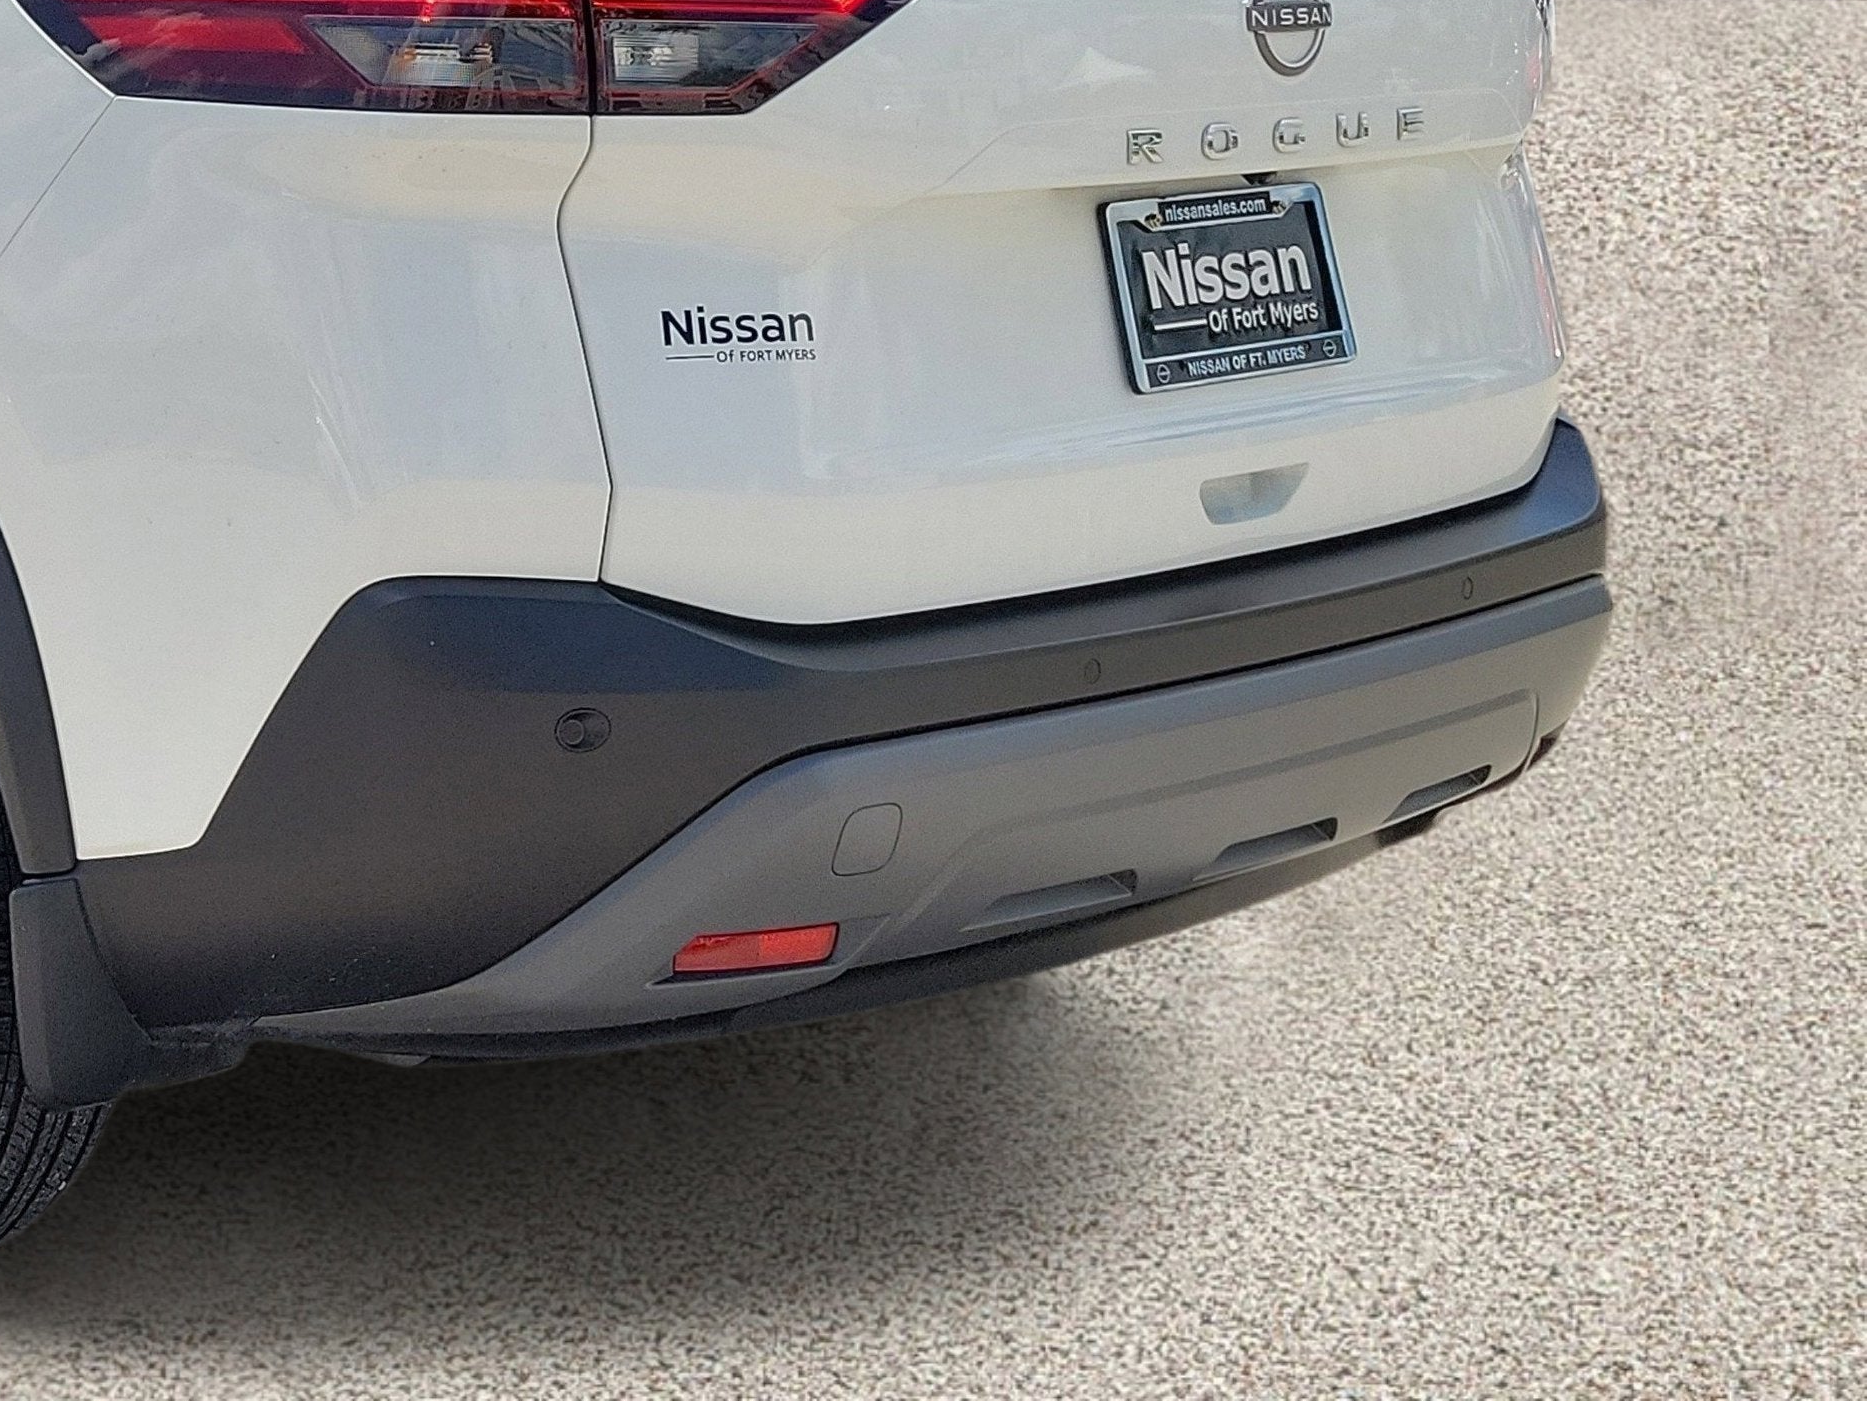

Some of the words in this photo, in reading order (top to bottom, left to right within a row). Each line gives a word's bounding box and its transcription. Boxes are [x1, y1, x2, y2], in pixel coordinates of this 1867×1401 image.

[1250, 4, 1332, 28] NISSAN
[1126, 107, 1425, 165] ROGUE
[1164, 198, 1267, 222] nissansales.com
[1141, 242, 1312, 309] Nissan
[661, 306, 815, 346] Nissan
[1208, 310, 1229, 333] Of
[1233, 305, 1269, 330] Fort
[1270, 300, 1320, 328] Myers
[740, 349, 772, 362] FORT
[775, 349, 817, 361] MYERS
[1187, 357, 1231, 376] NISSAN
[1232, 354, 1249, 370] OF
[1250, 351, 1267, 368] FT.
[1267, 346, 1307, 366] MYERS
